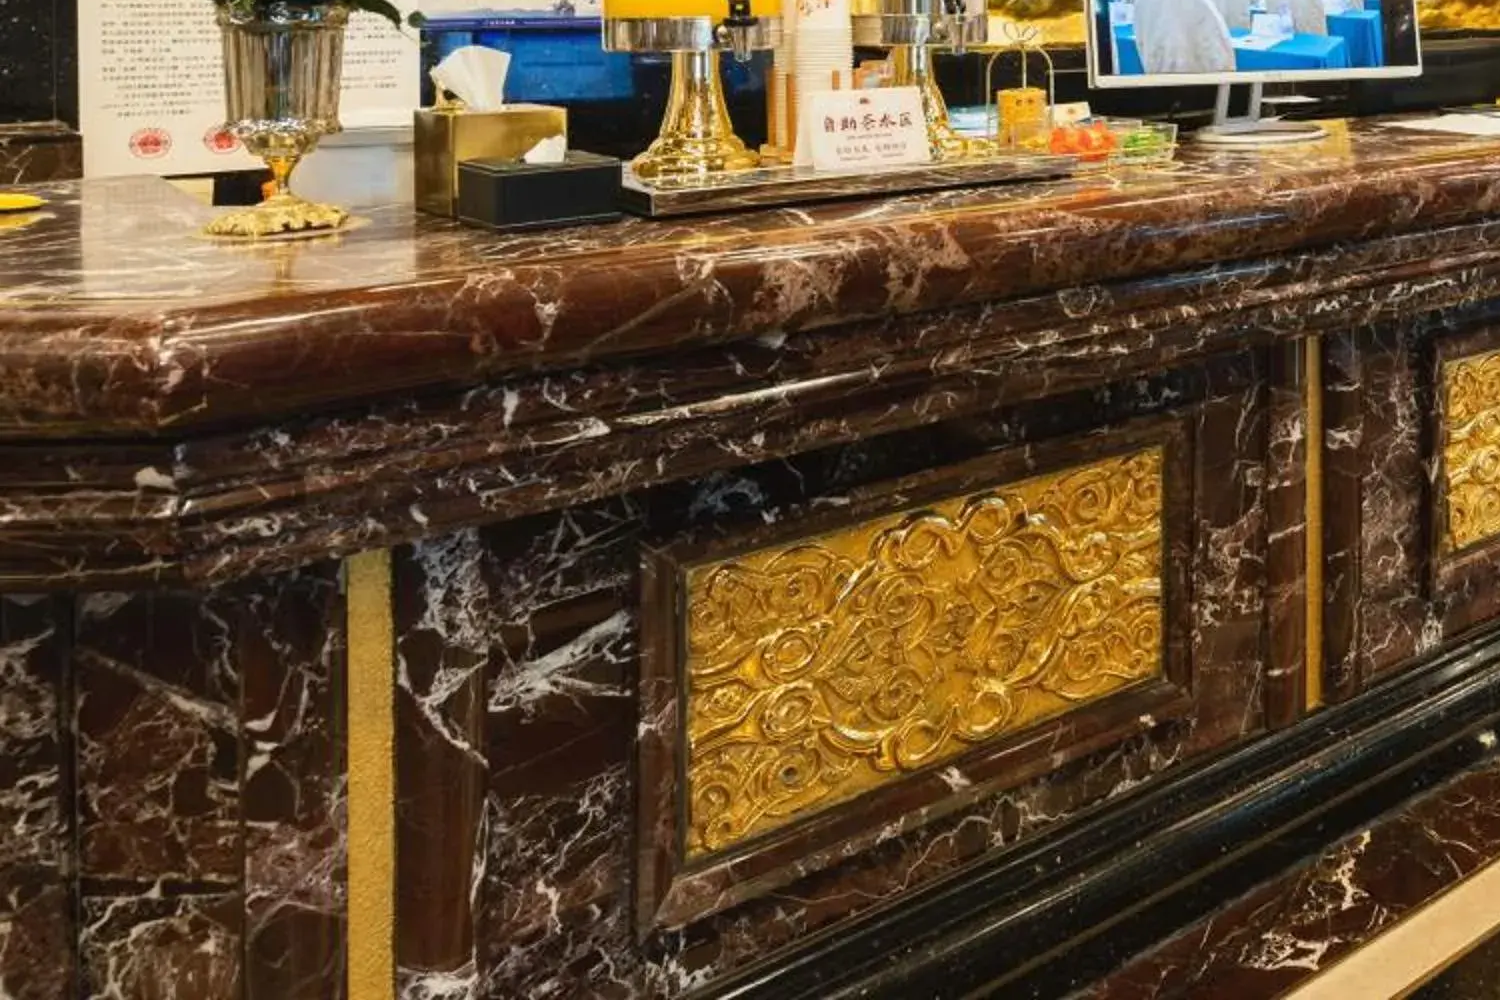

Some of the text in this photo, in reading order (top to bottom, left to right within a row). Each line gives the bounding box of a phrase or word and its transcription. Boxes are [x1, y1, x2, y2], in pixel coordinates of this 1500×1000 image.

[823, 112, 913, 133] 自助茶水区
